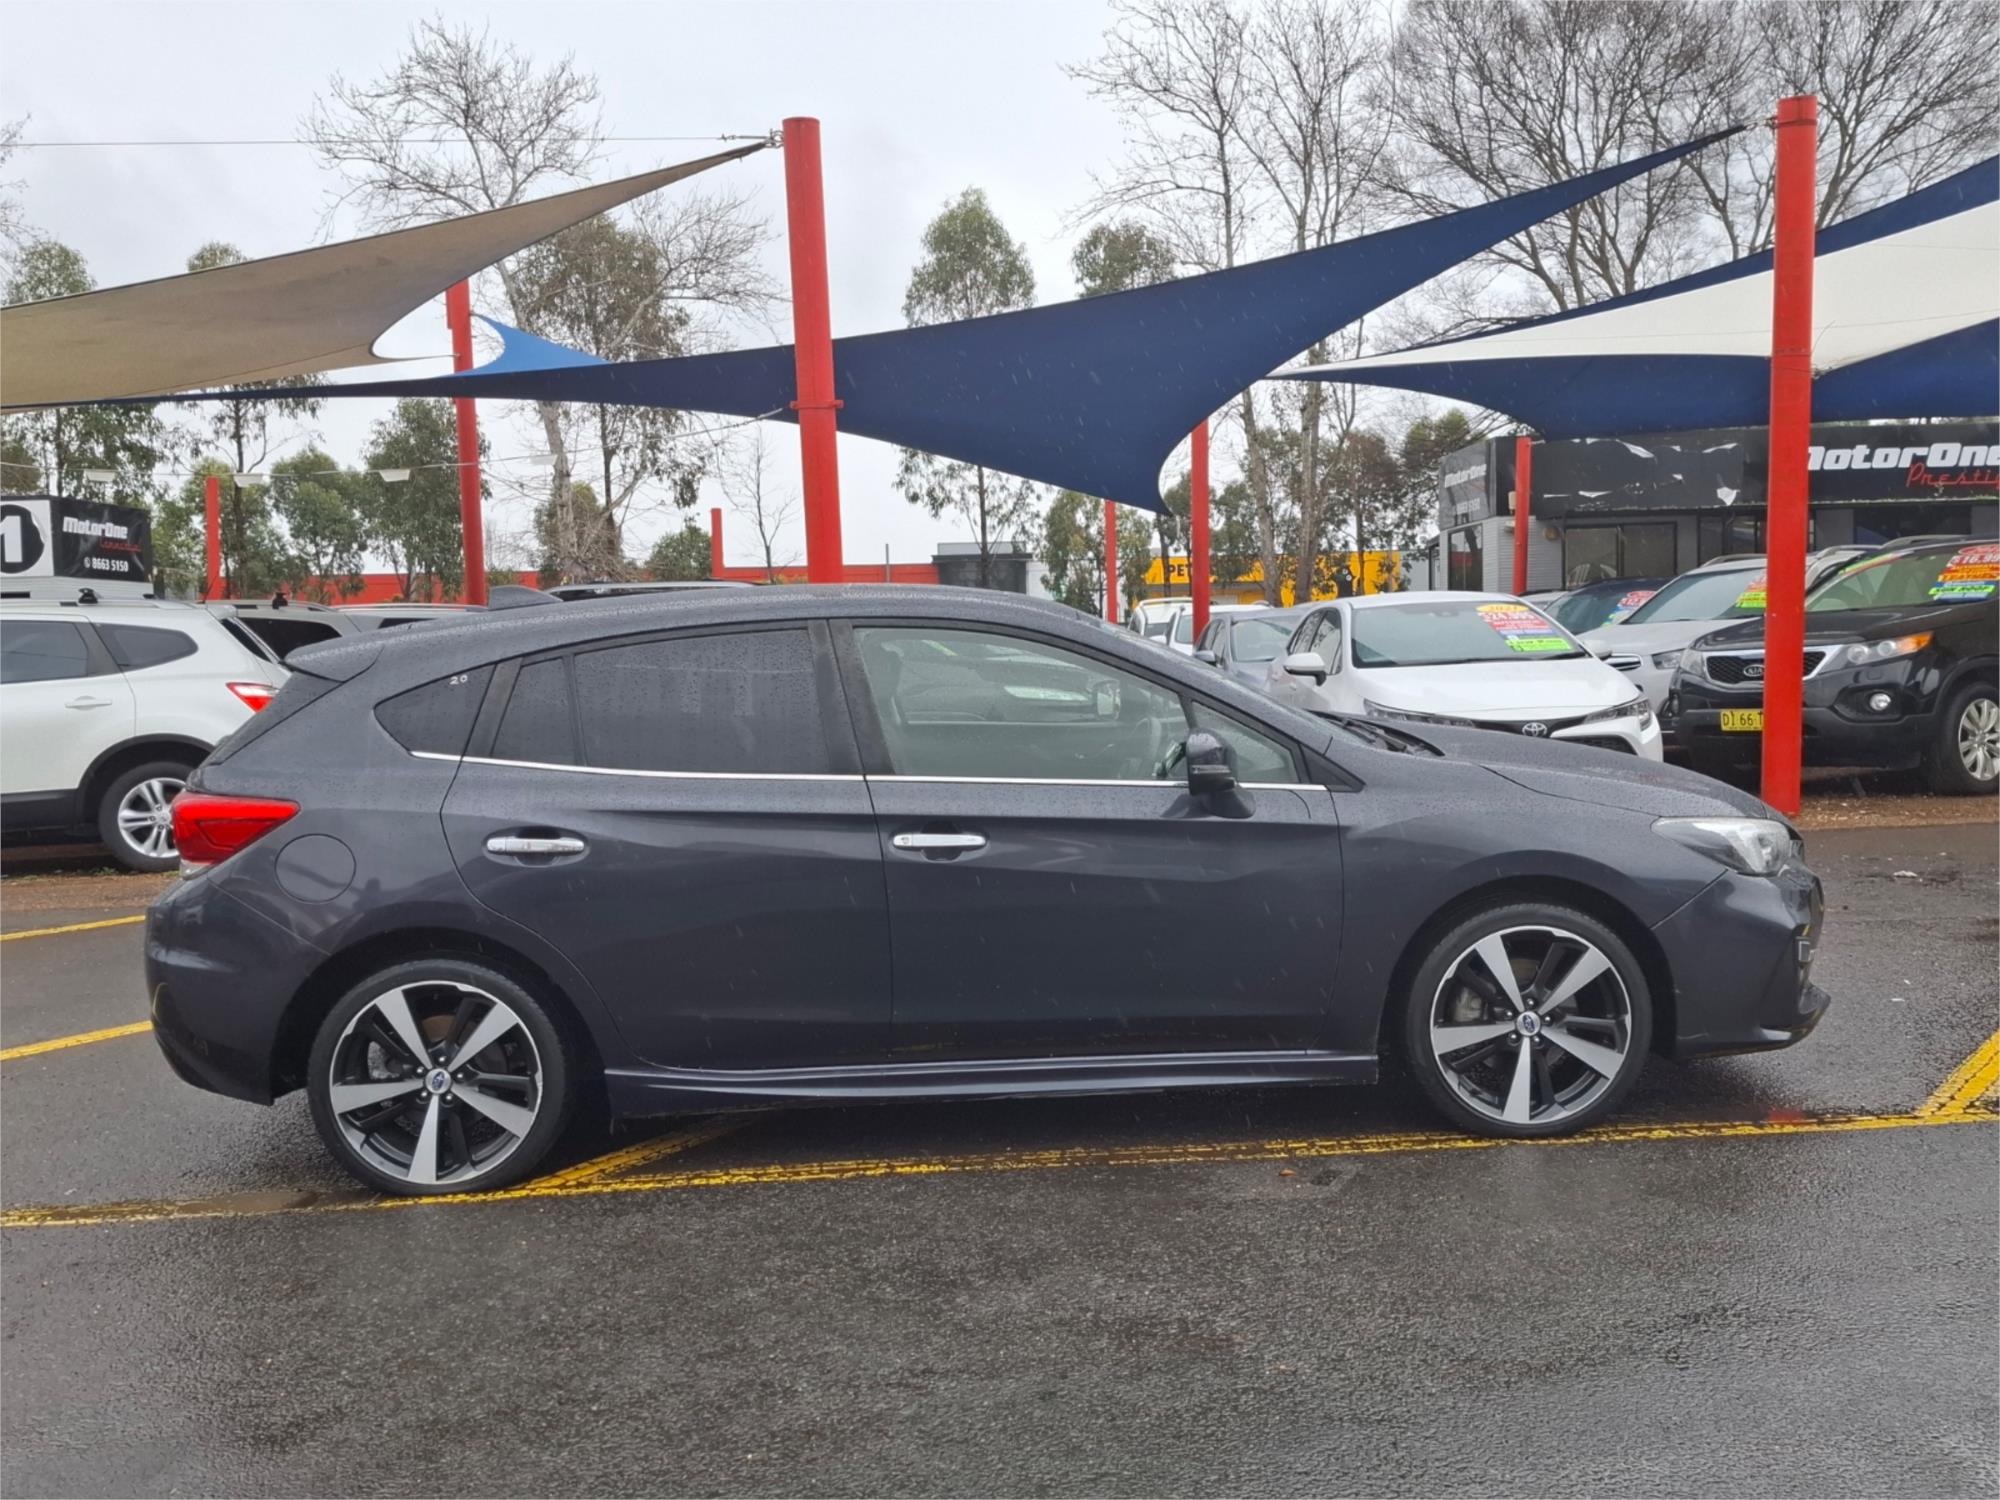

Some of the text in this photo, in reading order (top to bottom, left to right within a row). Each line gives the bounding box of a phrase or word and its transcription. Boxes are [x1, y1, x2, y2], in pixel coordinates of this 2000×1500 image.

[1906, 462, 1999, 488] Presti
[62, 516, 128, 539] MotorOne
[92, 557, 129, 573] 8663 5150
